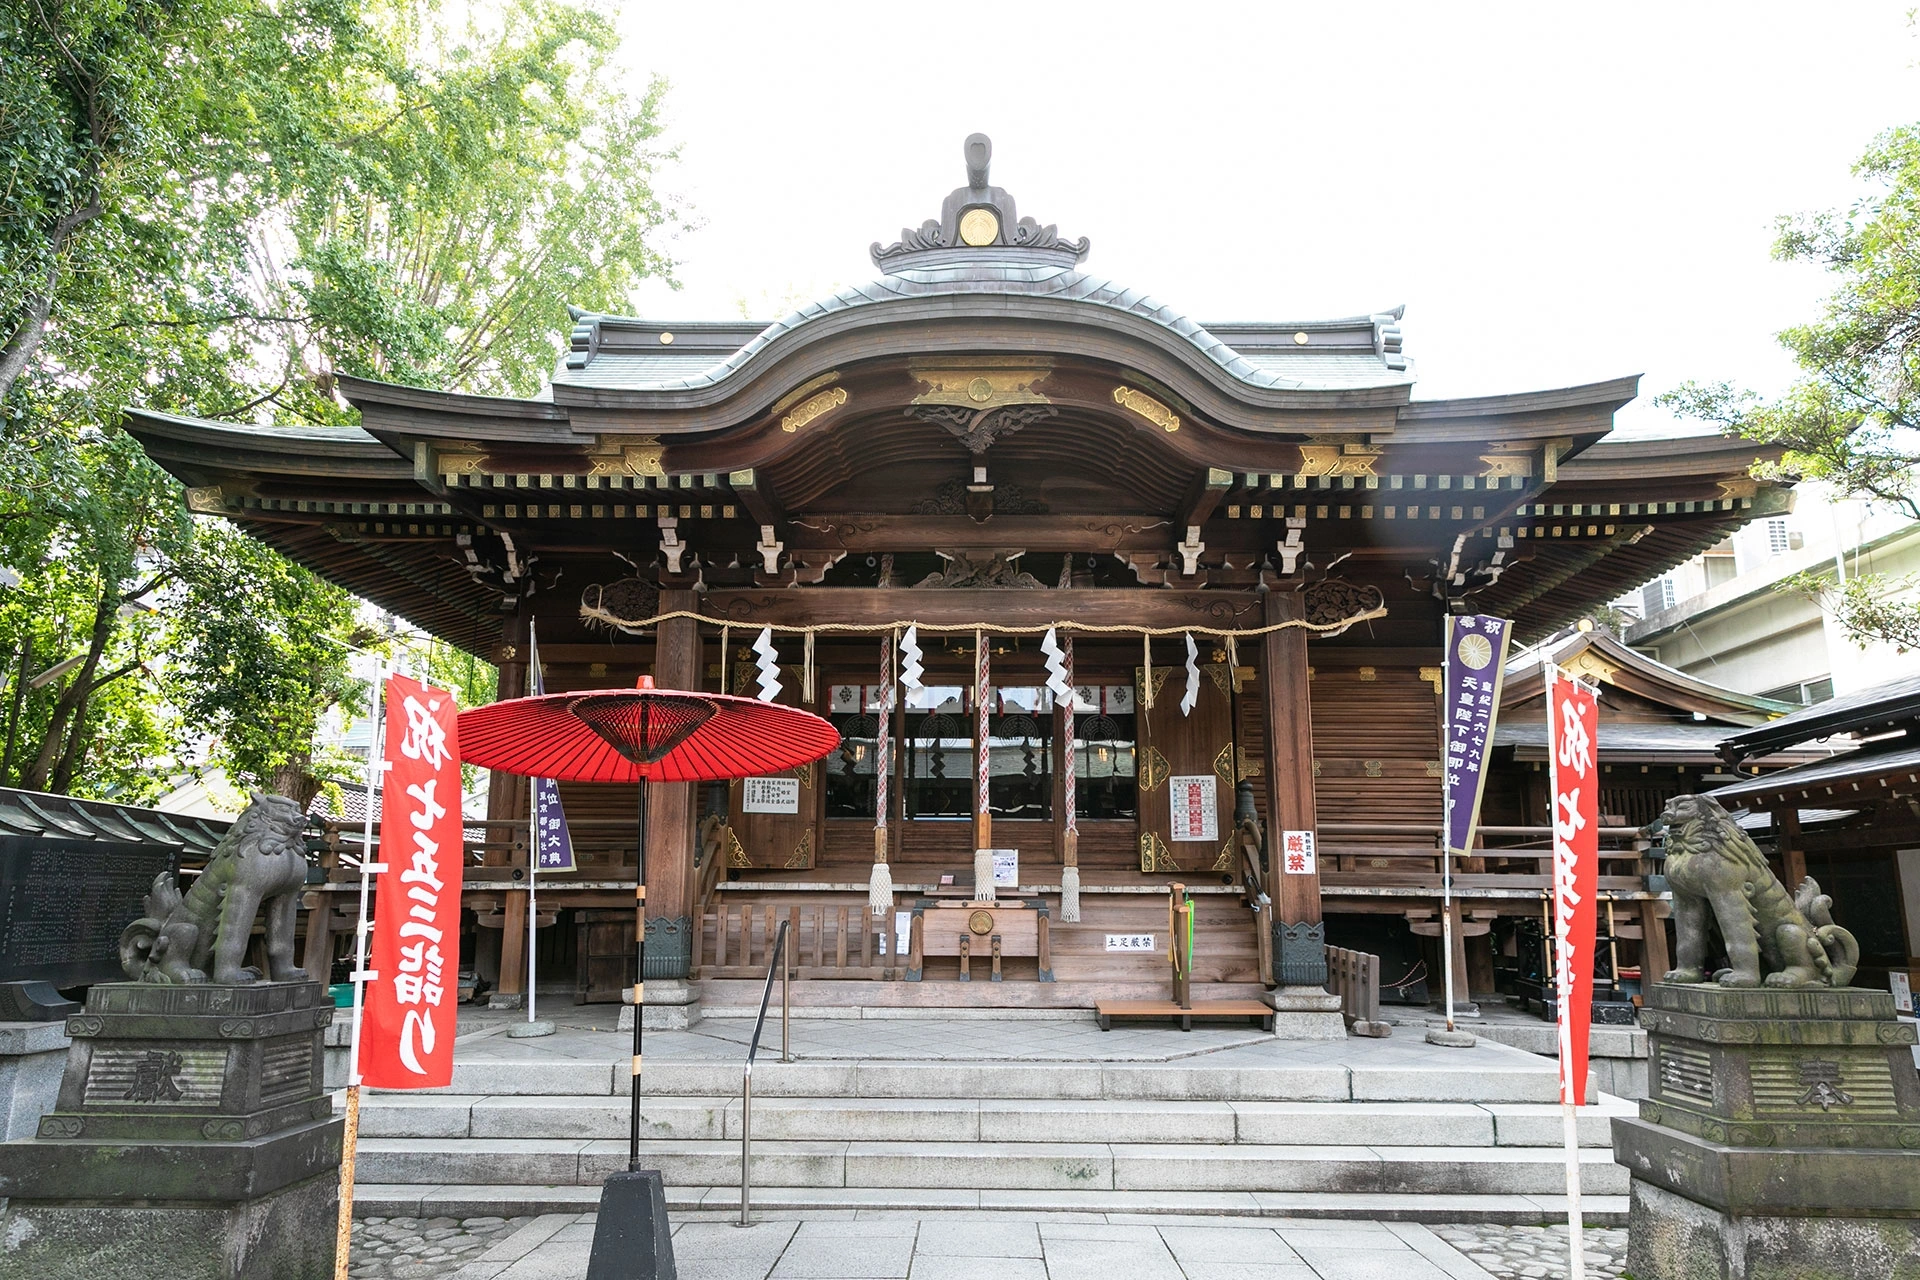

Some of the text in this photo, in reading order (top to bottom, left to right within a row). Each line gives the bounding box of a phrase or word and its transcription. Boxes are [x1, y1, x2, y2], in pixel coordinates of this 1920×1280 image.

[1466, 680, 1493, 773] 皇紀二六七九年
[1287, 835, 1305, 871] 厳禁
[1107, 936, 1152, 948] 土足厳禁
